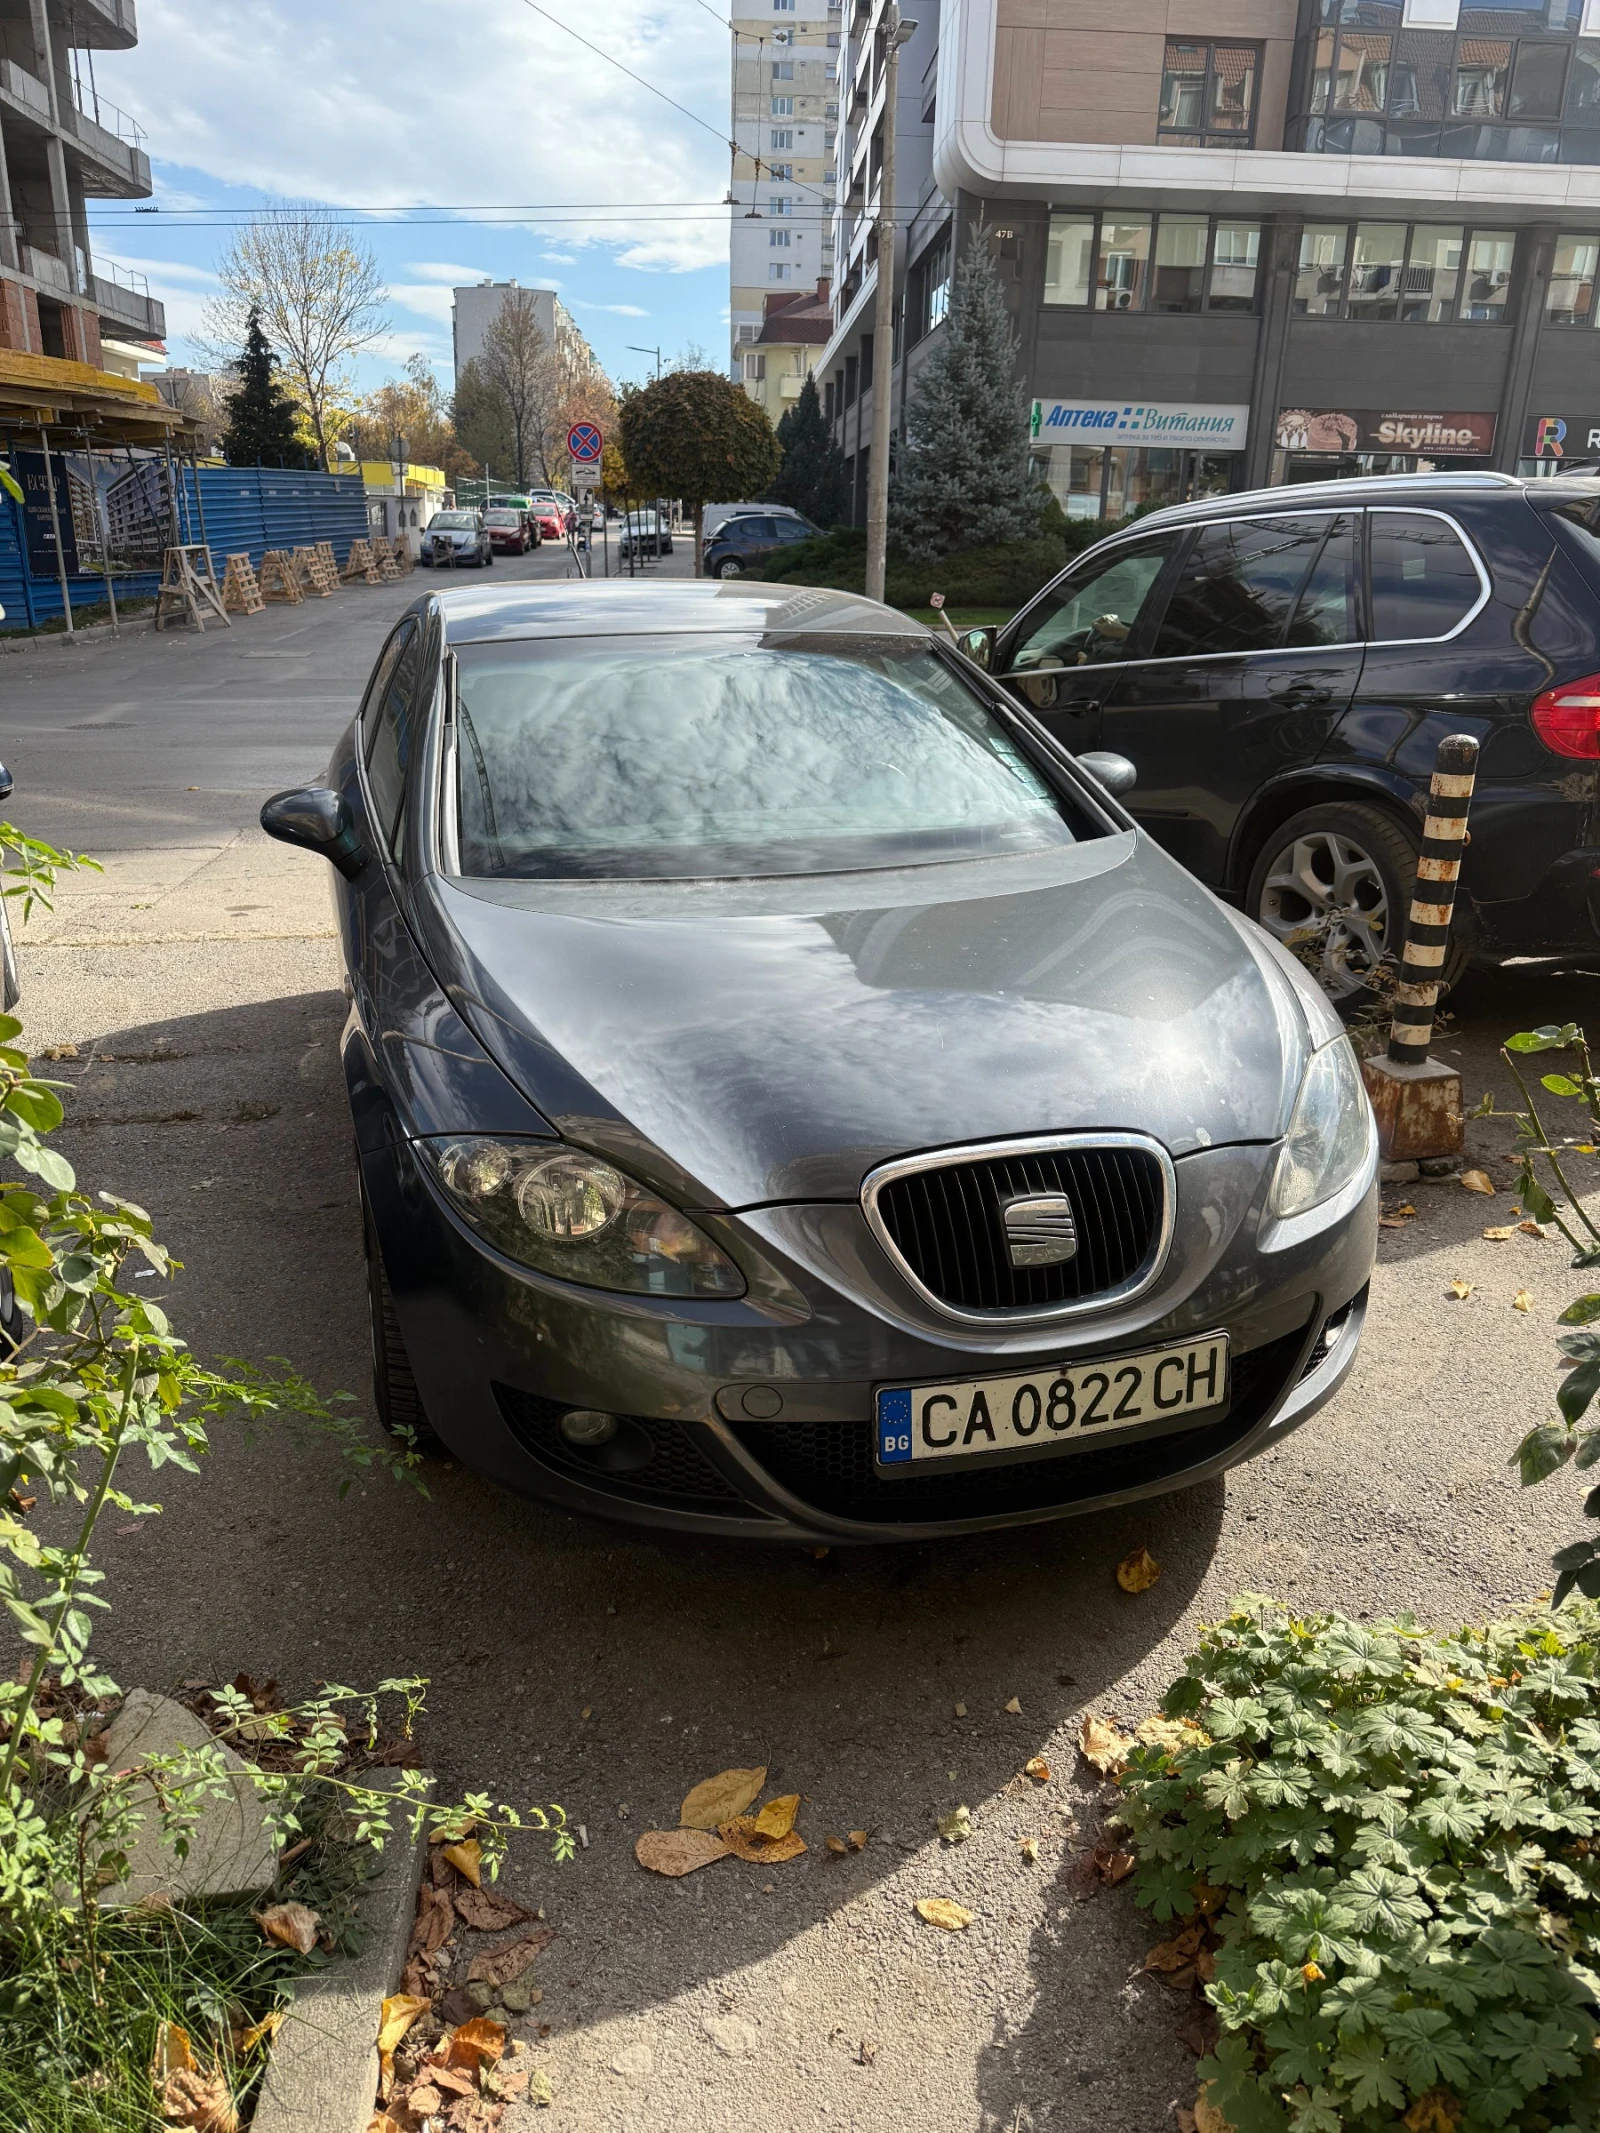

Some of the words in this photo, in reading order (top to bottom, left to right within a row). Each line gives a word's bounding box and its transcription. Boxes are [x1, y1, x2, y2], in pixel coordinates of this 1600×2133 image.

[1045, 405, 1119, 429] Аптека
[1143, 408, 1235, 433] Витания
[1116, 433, 1140, 441] аптека
[1150, 433, 1162, 441] теб
[1194, 435, 1231, 443] семейство
[1378, 420, 1473, 449] Skyline
[921, 1390, 996, 1448] CA
[1012, 1367, 1142, 1437] 0822
[1153, 1346, 1218, 1410] CH
[884, 1434, 910, 1452] BG
